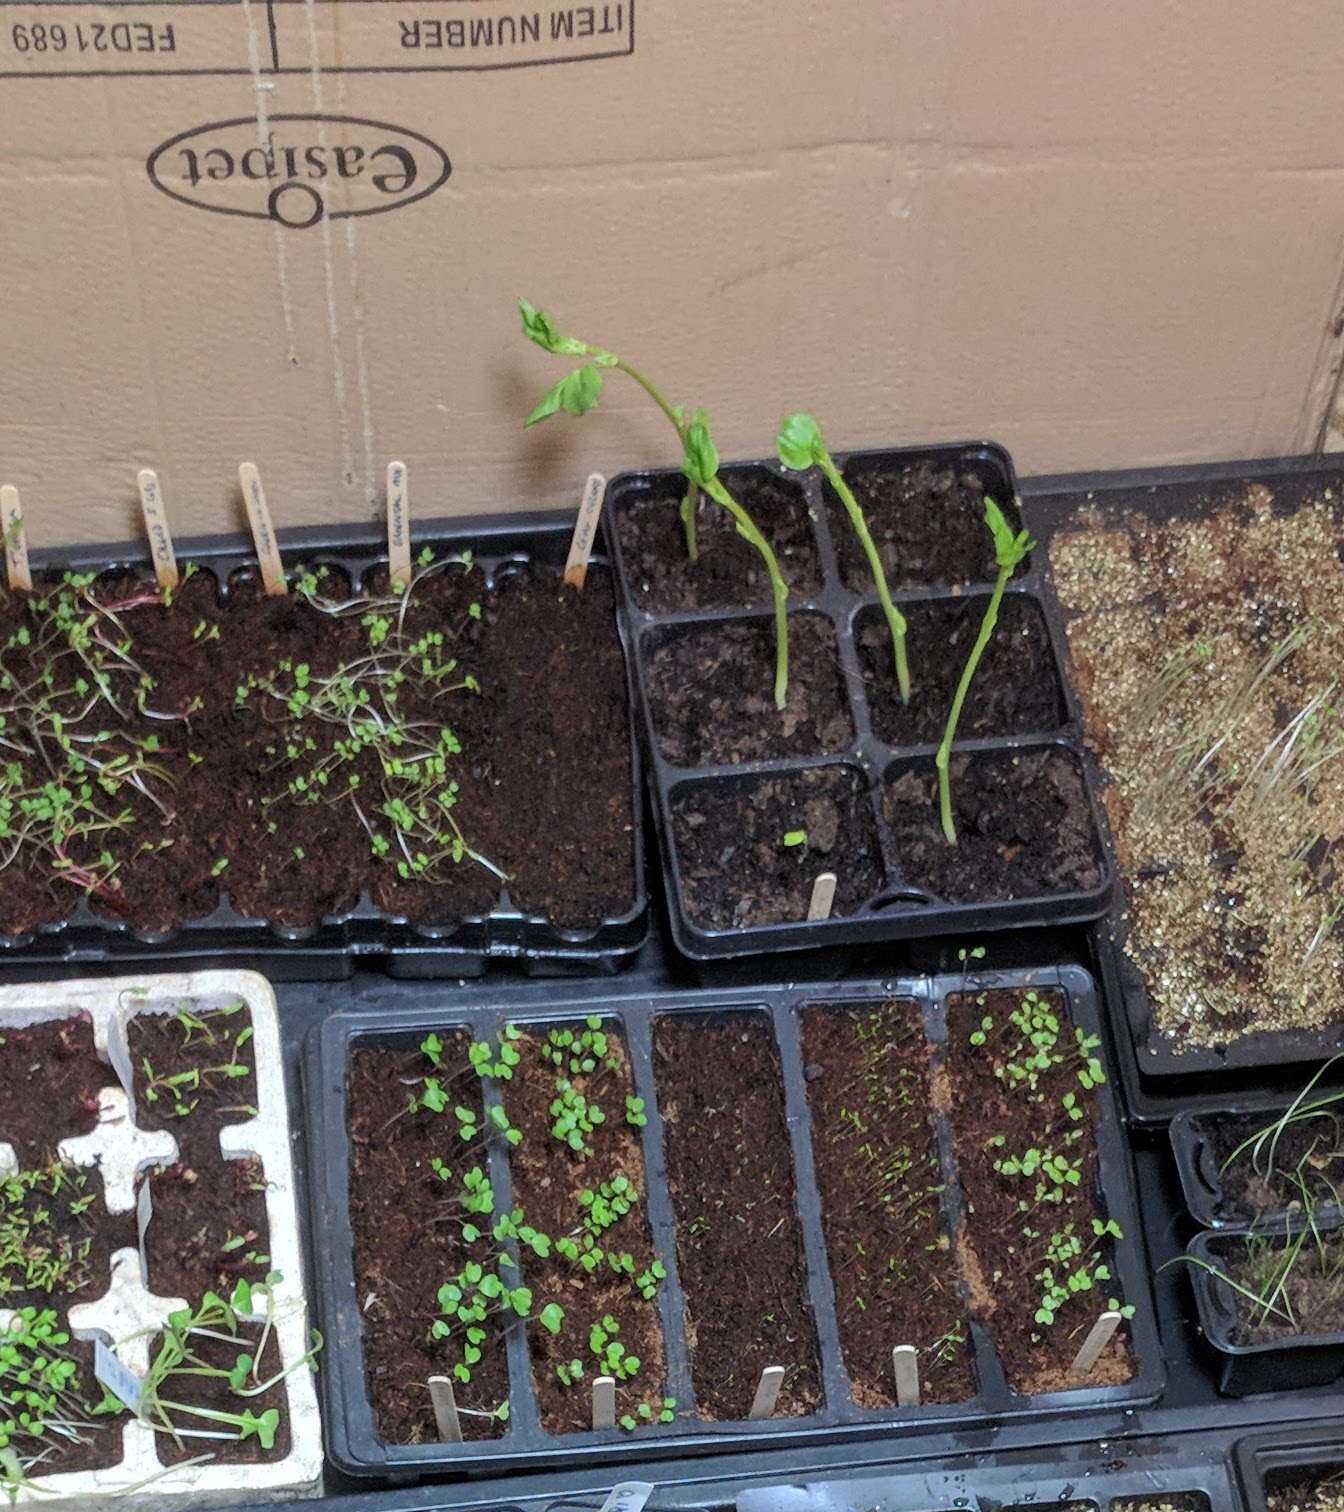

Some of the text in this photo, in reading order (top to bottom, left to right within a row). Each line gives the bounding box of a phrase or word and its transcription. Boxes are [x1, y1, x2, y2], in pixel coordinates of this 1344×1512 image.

[399, 4, 623, 48] ITEM NUMBER
[178, 131, 418, 194] easipet
